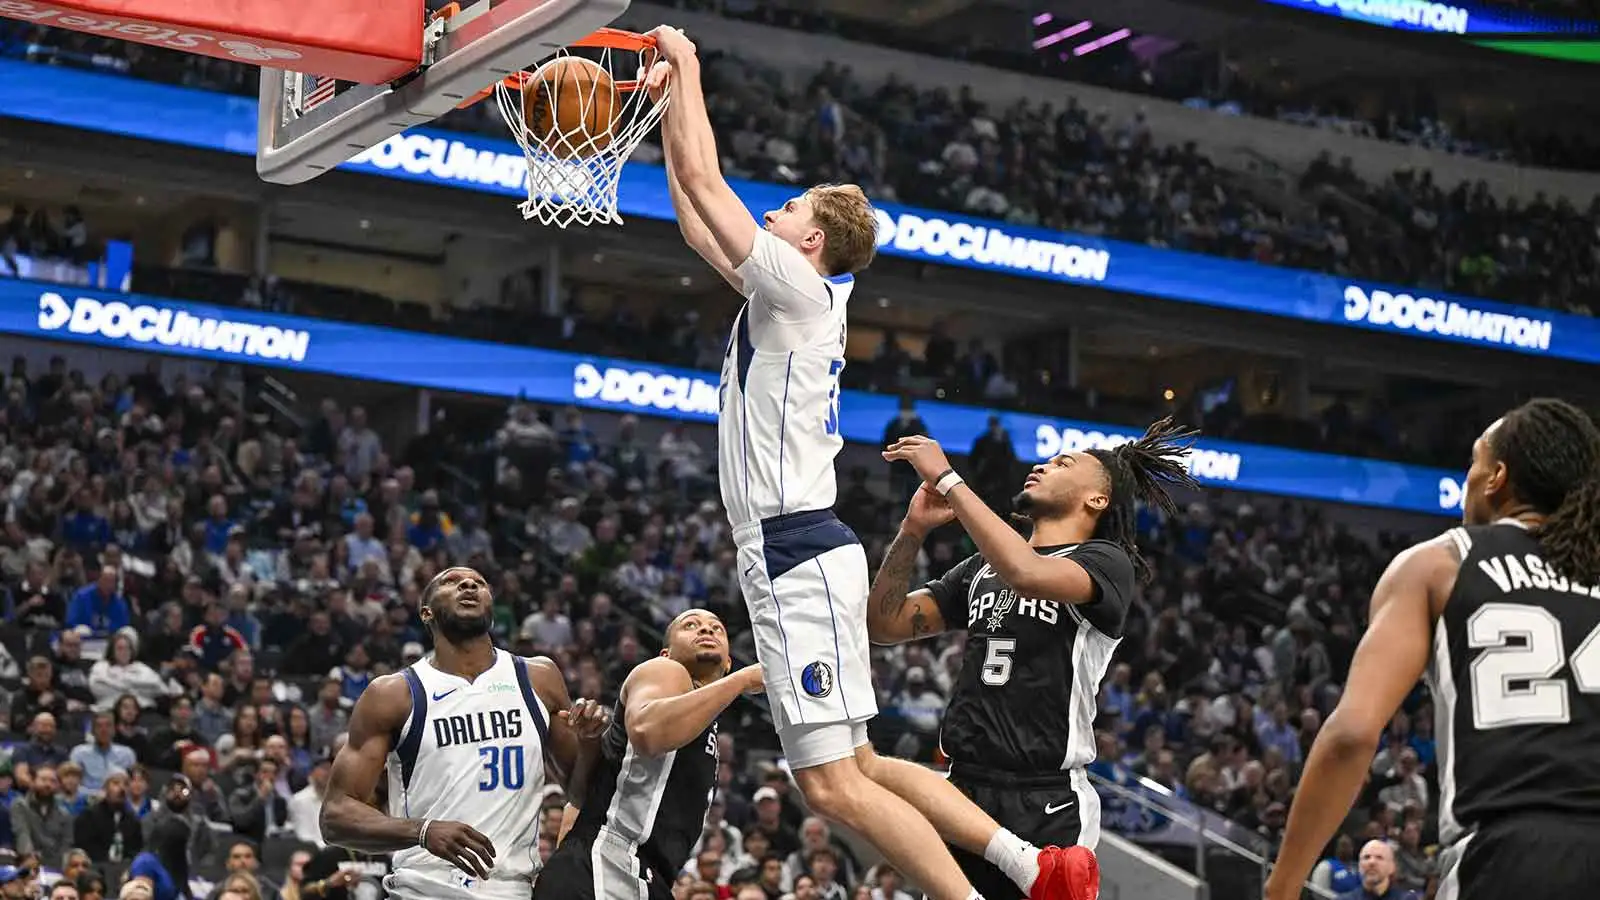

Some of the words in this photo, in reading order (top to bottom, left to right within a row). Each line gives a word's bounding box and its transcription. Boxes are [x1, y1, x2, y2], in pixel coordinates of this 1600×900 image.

[58, 16, 215, 48] State
[894, 213, 1110, 281] DOCUMATION
[69, 297, 309, 361] DOCUMATION
[1367, 290, 1552, 350] DOCUMATION
[981, 637, 1016, 686] 5
[487, 682, 517, 693] chime
[433, 709, 522, 748] DALLAS
[478, 745, 525, 792] 30
